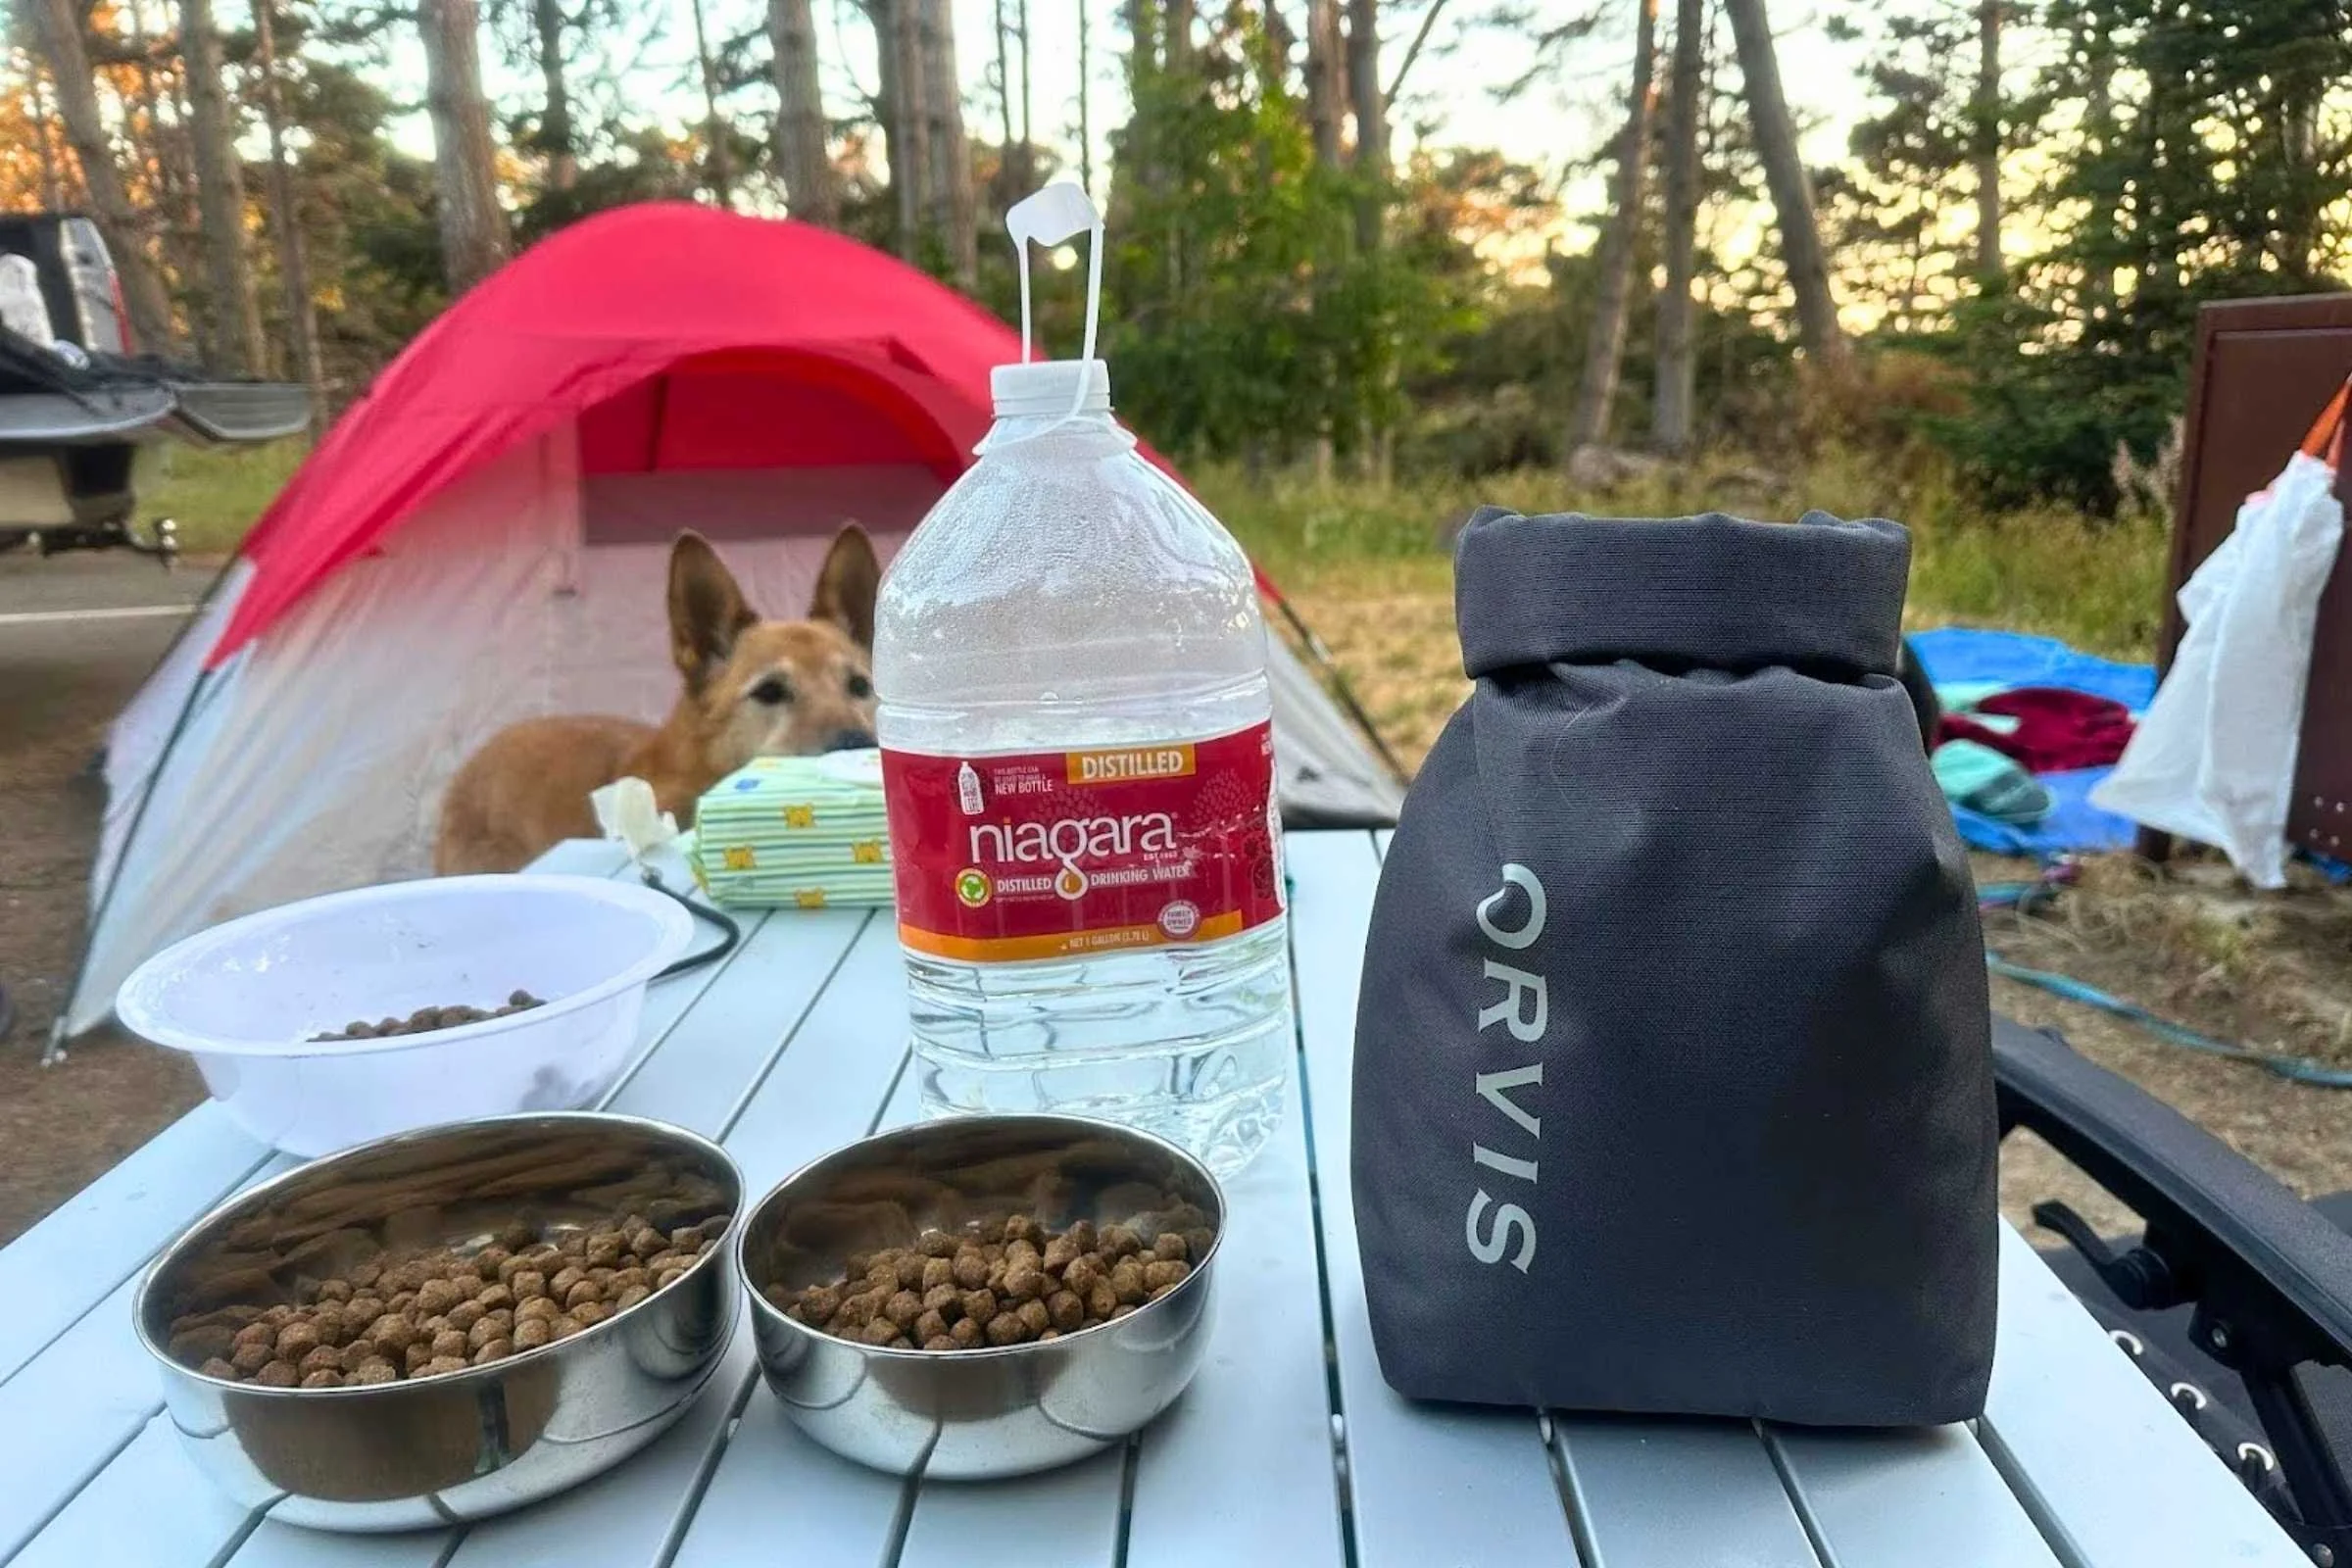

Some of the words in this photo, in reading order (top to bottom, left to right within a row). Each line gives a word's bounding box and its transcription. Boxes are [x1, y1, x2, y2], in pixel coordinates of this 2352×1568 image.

[1081, 751, 1183, 779] DISTILLED
[995, 783, 1016, 795] NEW
[1017, 779, 1054, 794] BOTTLE
[969, 811, 1178, 896] niagara
[997, 877, 1053, 893] DISTILLED
[1090, 869, 1148, 887] DRINKING
[1152, 864, 1190, 882] WATER
[1467, 862, 1547, 1275] ORVIS
